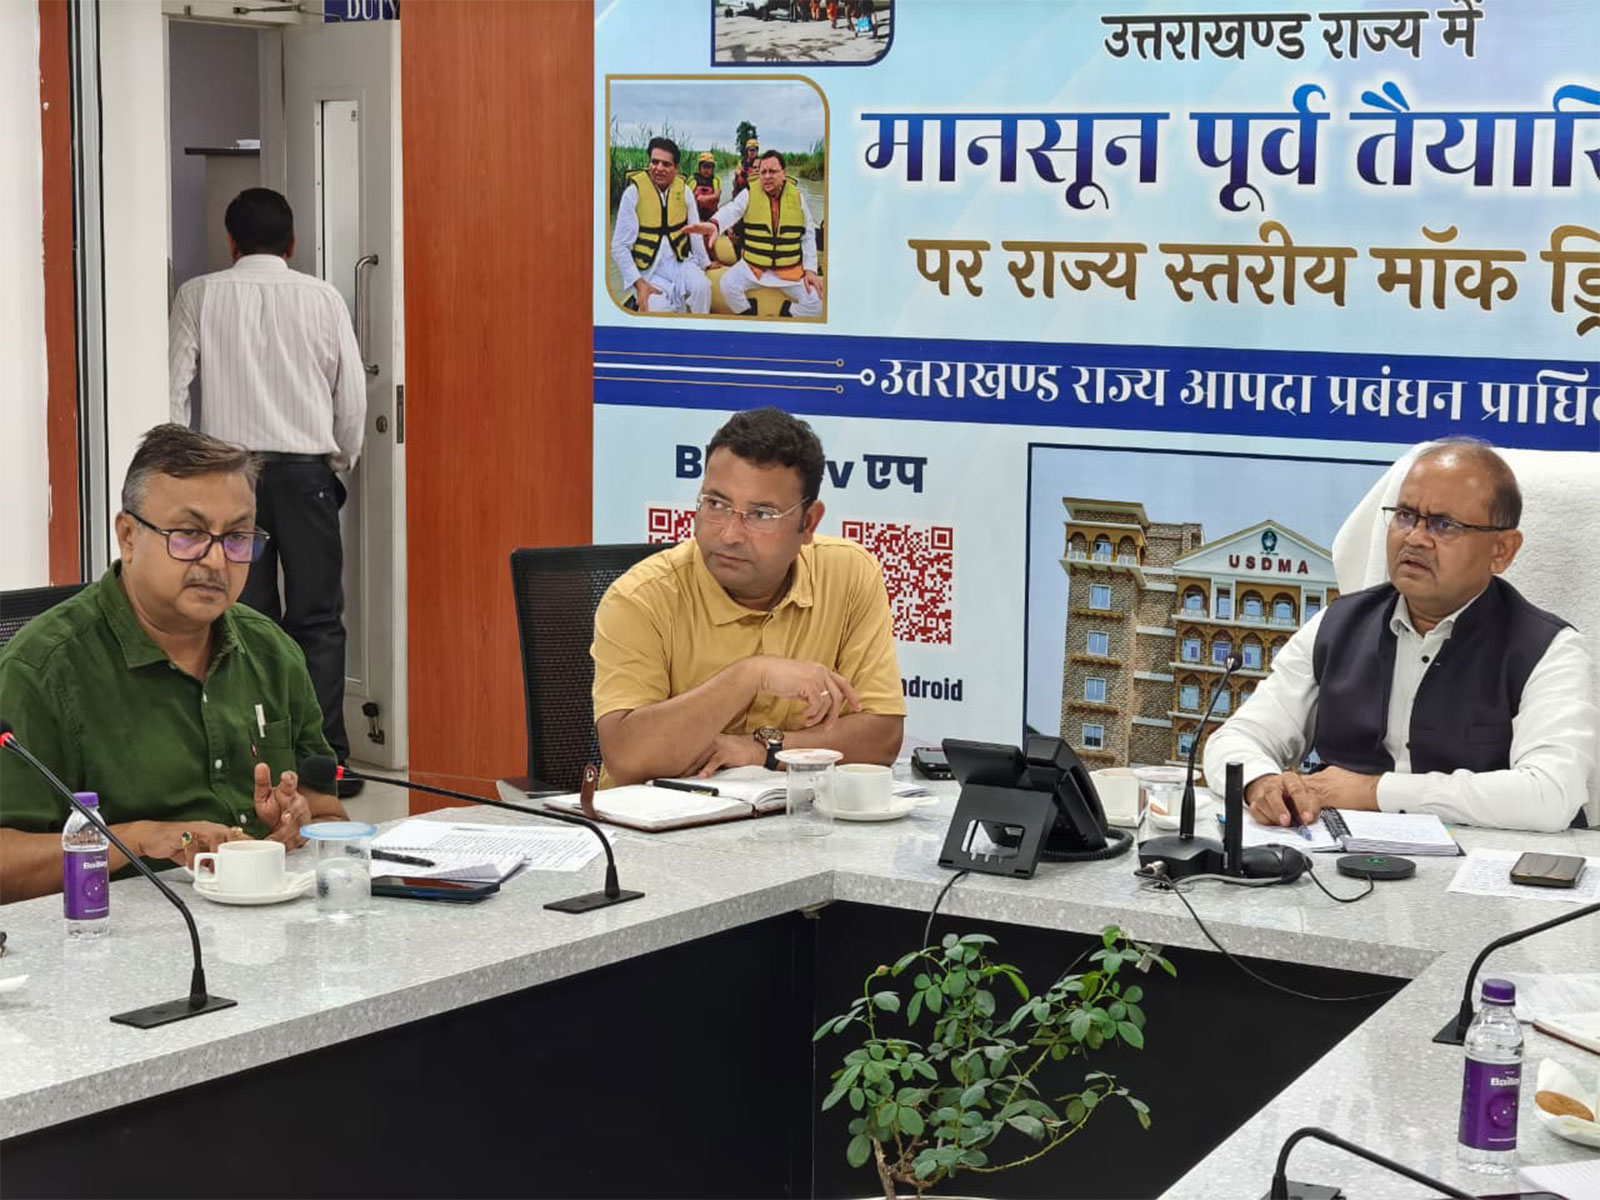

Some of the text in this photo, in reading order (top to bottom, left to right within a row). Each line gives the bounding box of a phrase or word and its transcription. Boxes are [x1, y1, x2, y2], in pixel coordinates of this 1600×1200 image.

[1101, 13, 1312, 60] उत्तराखण्ड
[1318, 11, 1430, 59] राज्य
[861, 112, 1171, 210] मानसून
[1189, 84, 1330, 212] पूर्व
[908, 239, 991, 297] पर
[1001, 240, 1148, 300] राज्य
[1158, 221, 1358, 307] स्तरीय
[1369, 225, 1527, 310] मॉक
[880, 359, 1062, 401] उत्तराखण्ड
[1071, 366, 1171, 406] राज्य
[1180, 369, 1317, 416] आपदा
[1326, 365, 1468, 421] प्रबंधन
[863, 454, 927, 493] एप
[1229, 554, 1309, 574] USDMA
[901, 675, 963, 702] droid
